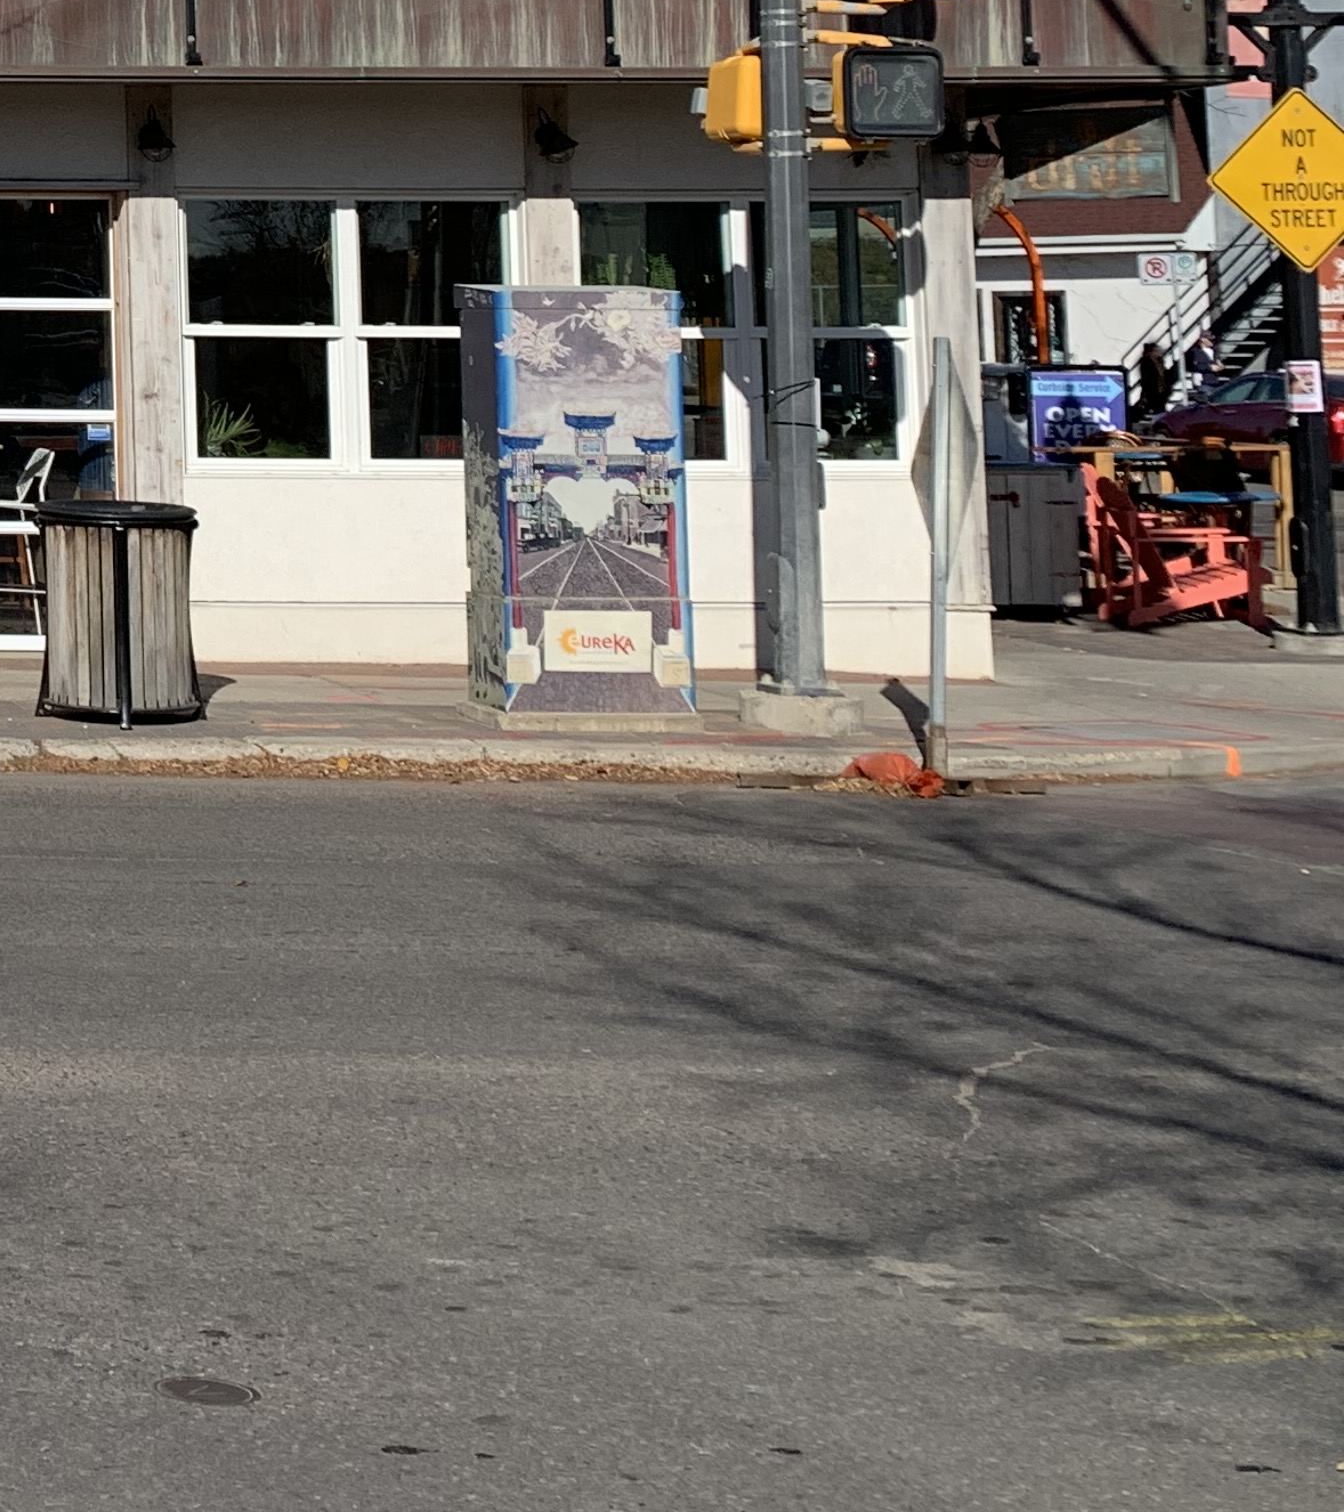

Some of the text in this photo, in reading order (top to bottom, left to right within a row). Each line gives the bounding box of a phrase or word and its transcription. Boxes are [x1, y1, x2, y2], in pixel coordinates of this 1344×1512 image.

[1281, 128, 1316, 148] NOT
[1295, 155, 1308, 175] A
[1261, 182, 1344, 202] THROUGH
[1270, 209, 1337, 228] STREET
[1045, 406, 1111, 423] OPEN
